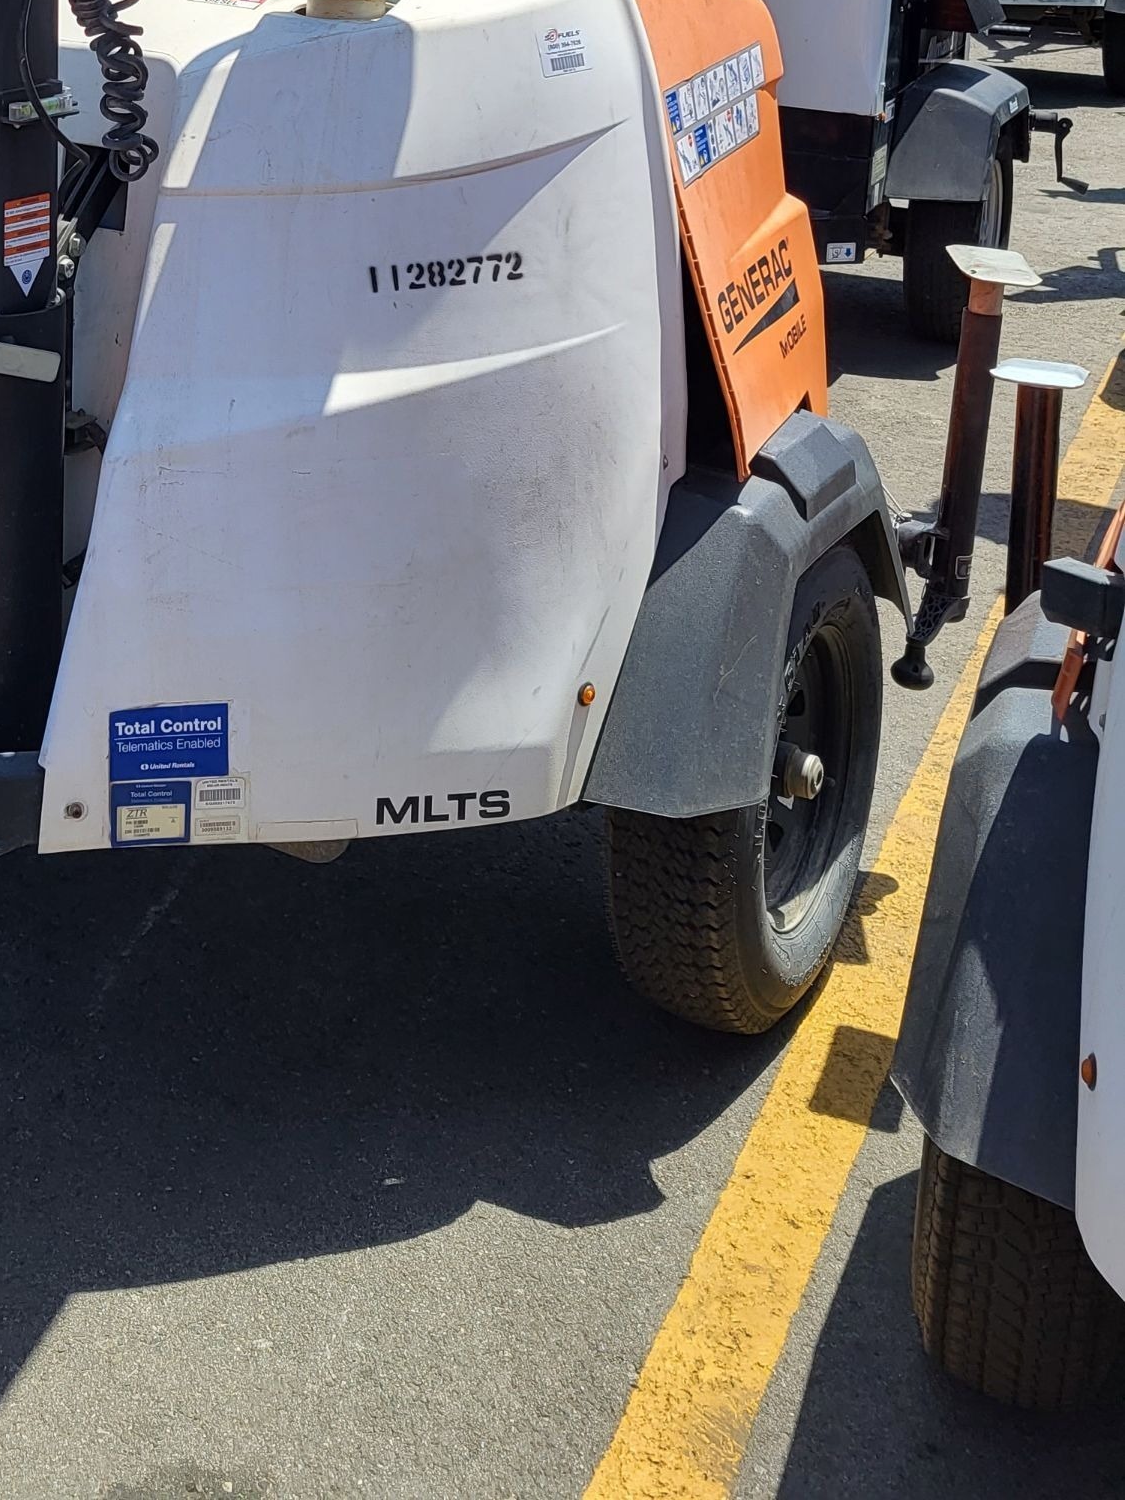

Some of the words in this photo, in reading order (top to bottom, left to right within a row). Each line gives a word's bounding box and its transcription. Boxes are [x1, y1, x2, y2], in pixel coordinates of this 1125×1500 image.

[557, 30, 581, 39] FUELS
[368, 252, 524, 293] 11282772
[717, 238, 793, 335] GENERAC
[778, 313, 807, 359] MOBILE
[115, 719, 155, 736] Total
[160, 716, 222, 734] Control
[116, 739, 174, 753] Telematics
[176, 737, 221, 750] Enabled
[149, 762, 172, 770] United
[130, 791, 147, 799] Total
[376, 789, 511, 825] MLTS
